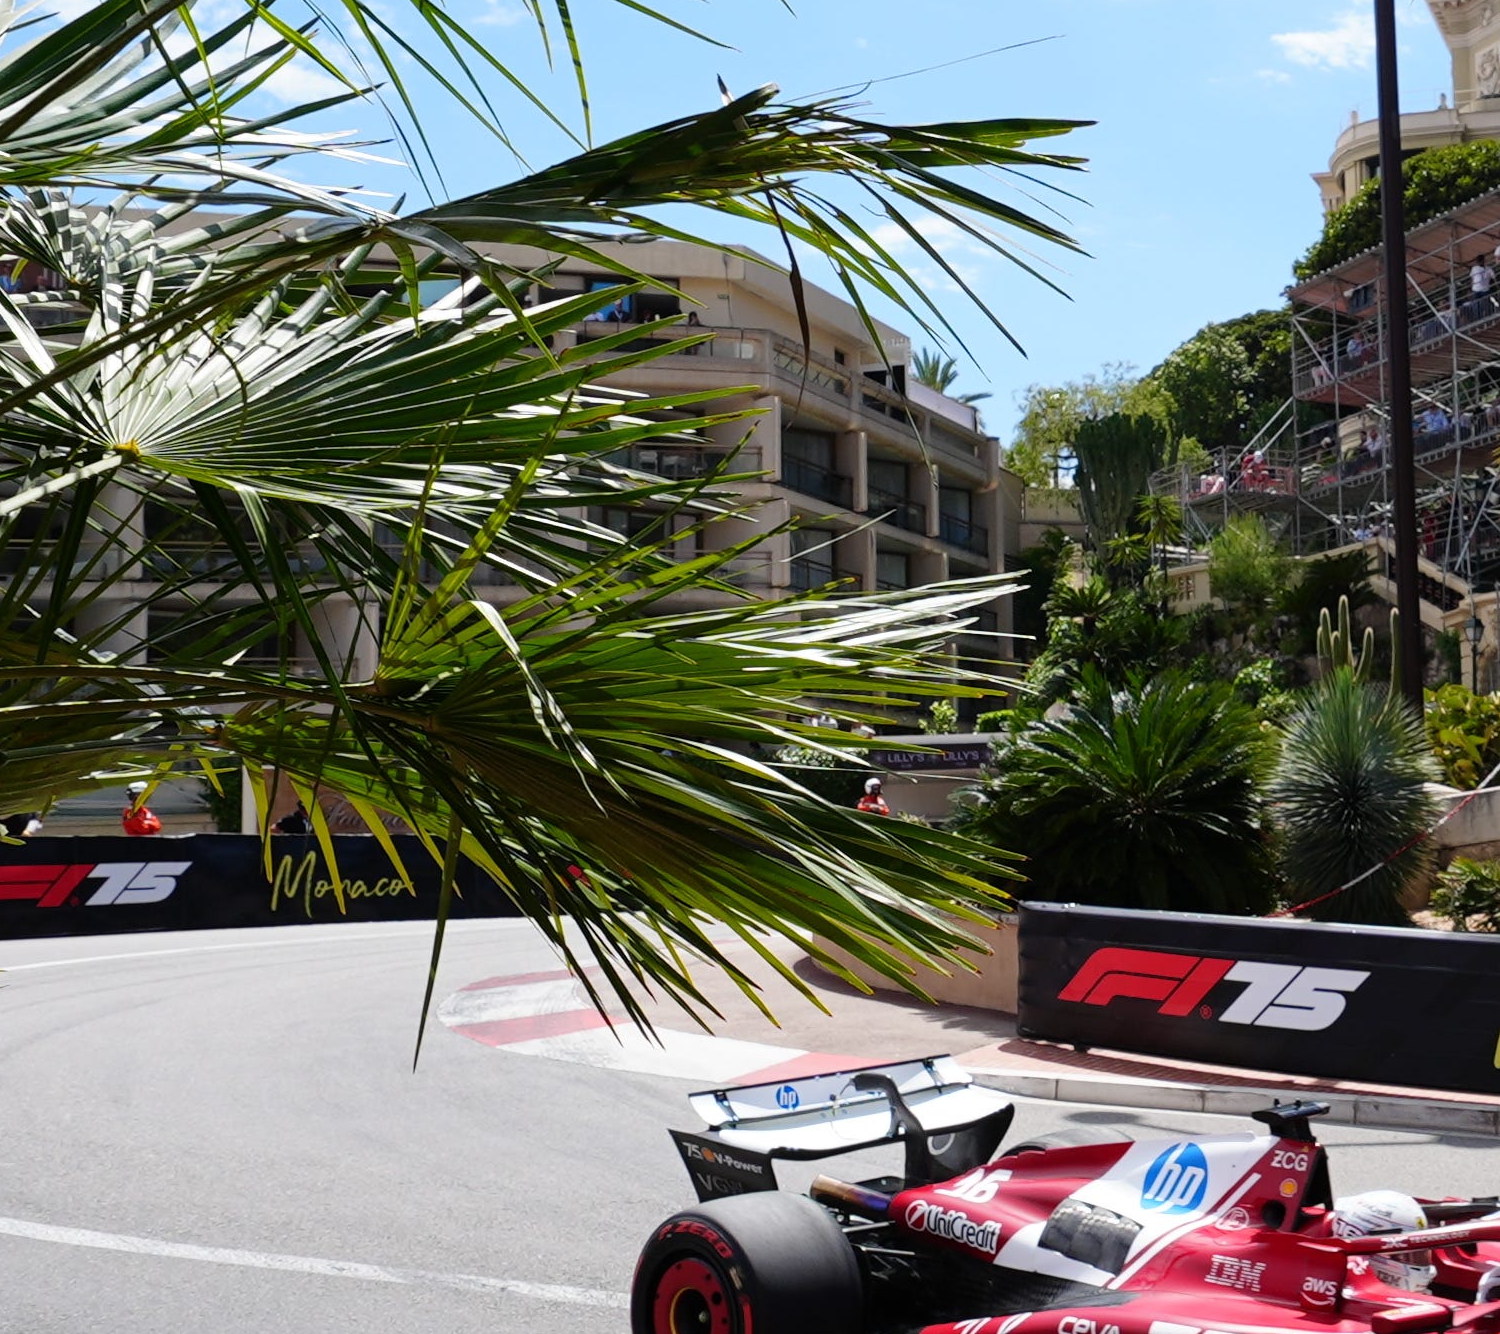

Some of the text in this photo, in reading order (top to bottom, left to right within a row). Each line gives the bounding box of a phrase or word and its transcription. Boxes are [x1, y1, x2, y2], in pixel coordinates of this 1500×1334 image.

[85, 861, 193, 906] 75
[1057, 947, 1235, 1017] F1
[1218, 960, 1371, 1031] 75
[1143, 1142, 1206, 1213] hp
[1271, 1149, 1309, 1172] ZCG
[926, 1204, 1003, 1255] UniCredit
[1204, 1254, 1267, 1292] IBM
[1302, 1276, 1337, 1297] aws
